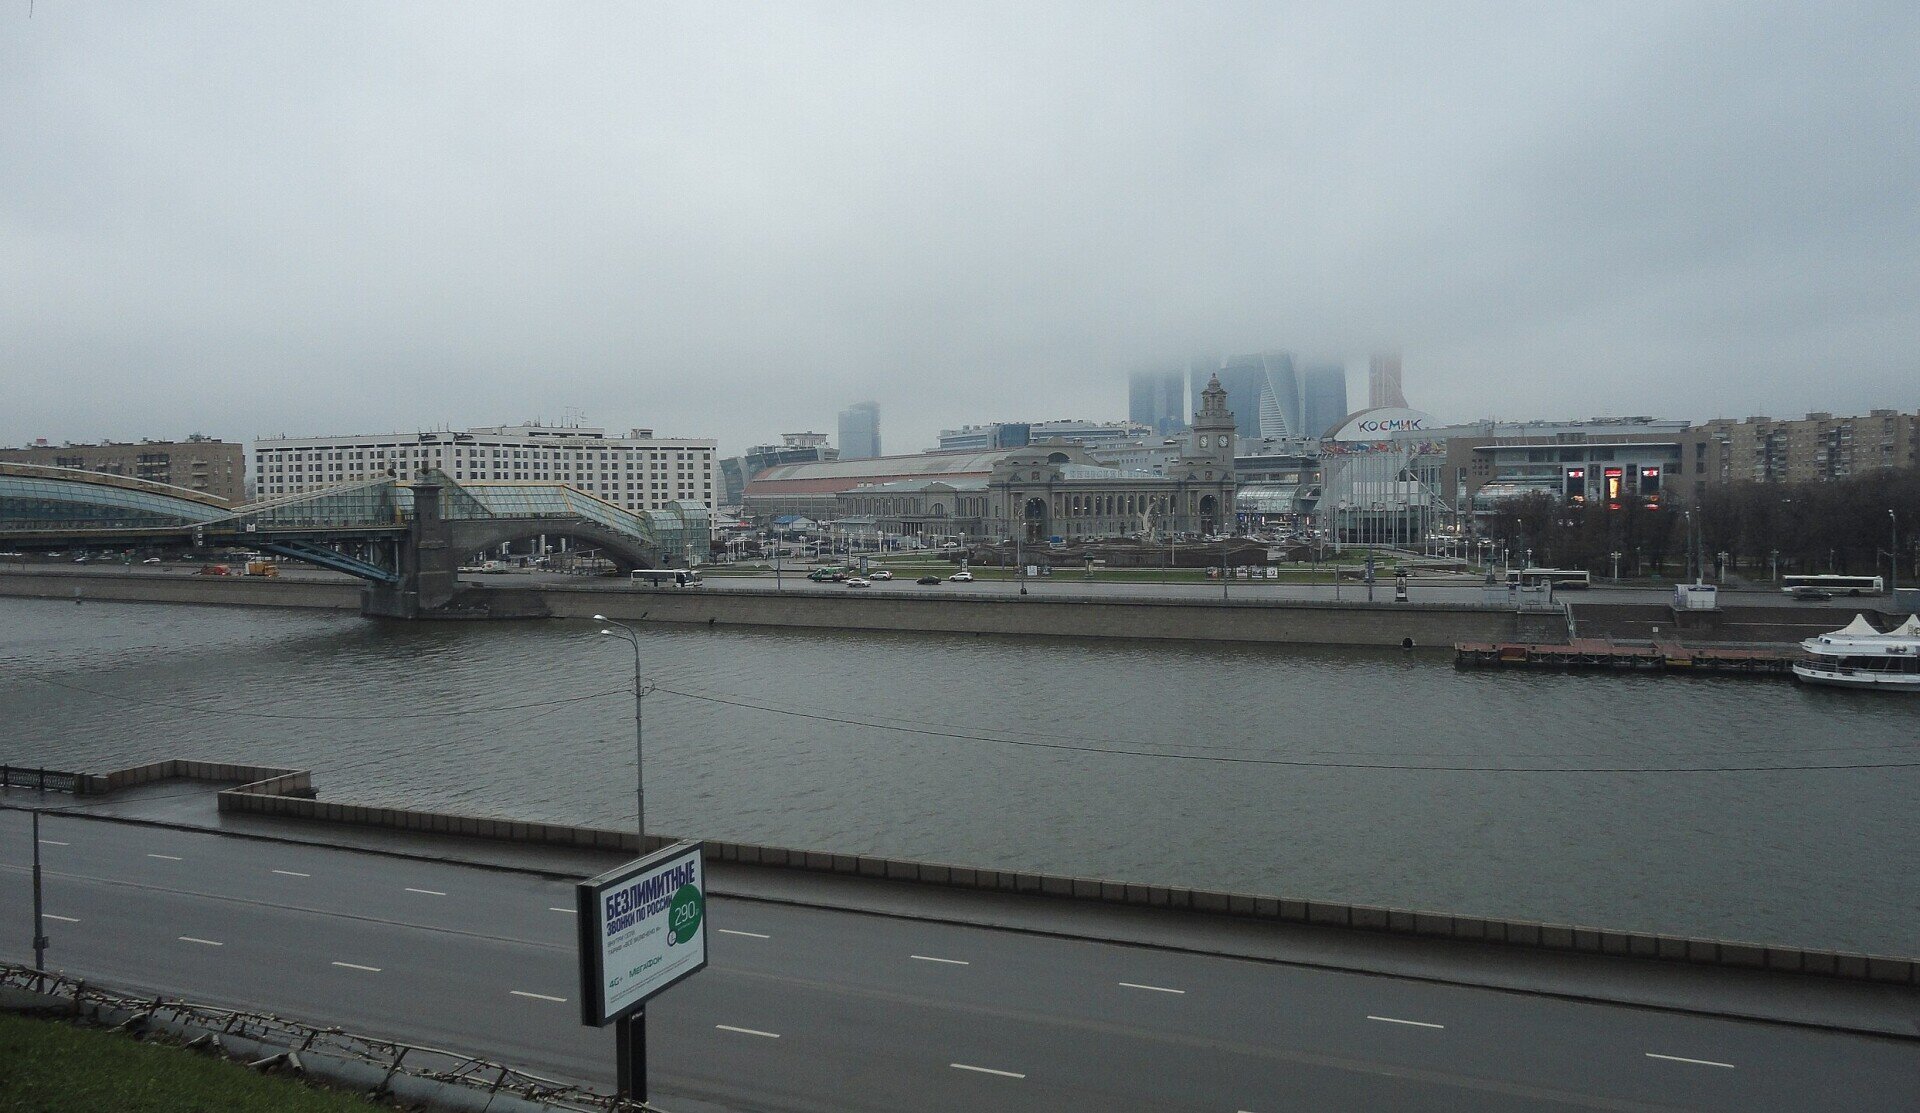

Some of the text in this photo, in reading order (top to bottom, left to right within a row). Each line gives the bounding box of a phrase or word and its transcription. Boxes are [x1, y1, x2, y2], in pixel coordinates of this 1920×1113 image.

[1358, 419, 1422, 432] КОСМИК
[606, 860, 695, 921] БЕЗЛИМИТНЫЕ
[606, 895, 672, 936] ЗВОНКИ ПО РОССИИ
[675, 901, 696, 926] 290
